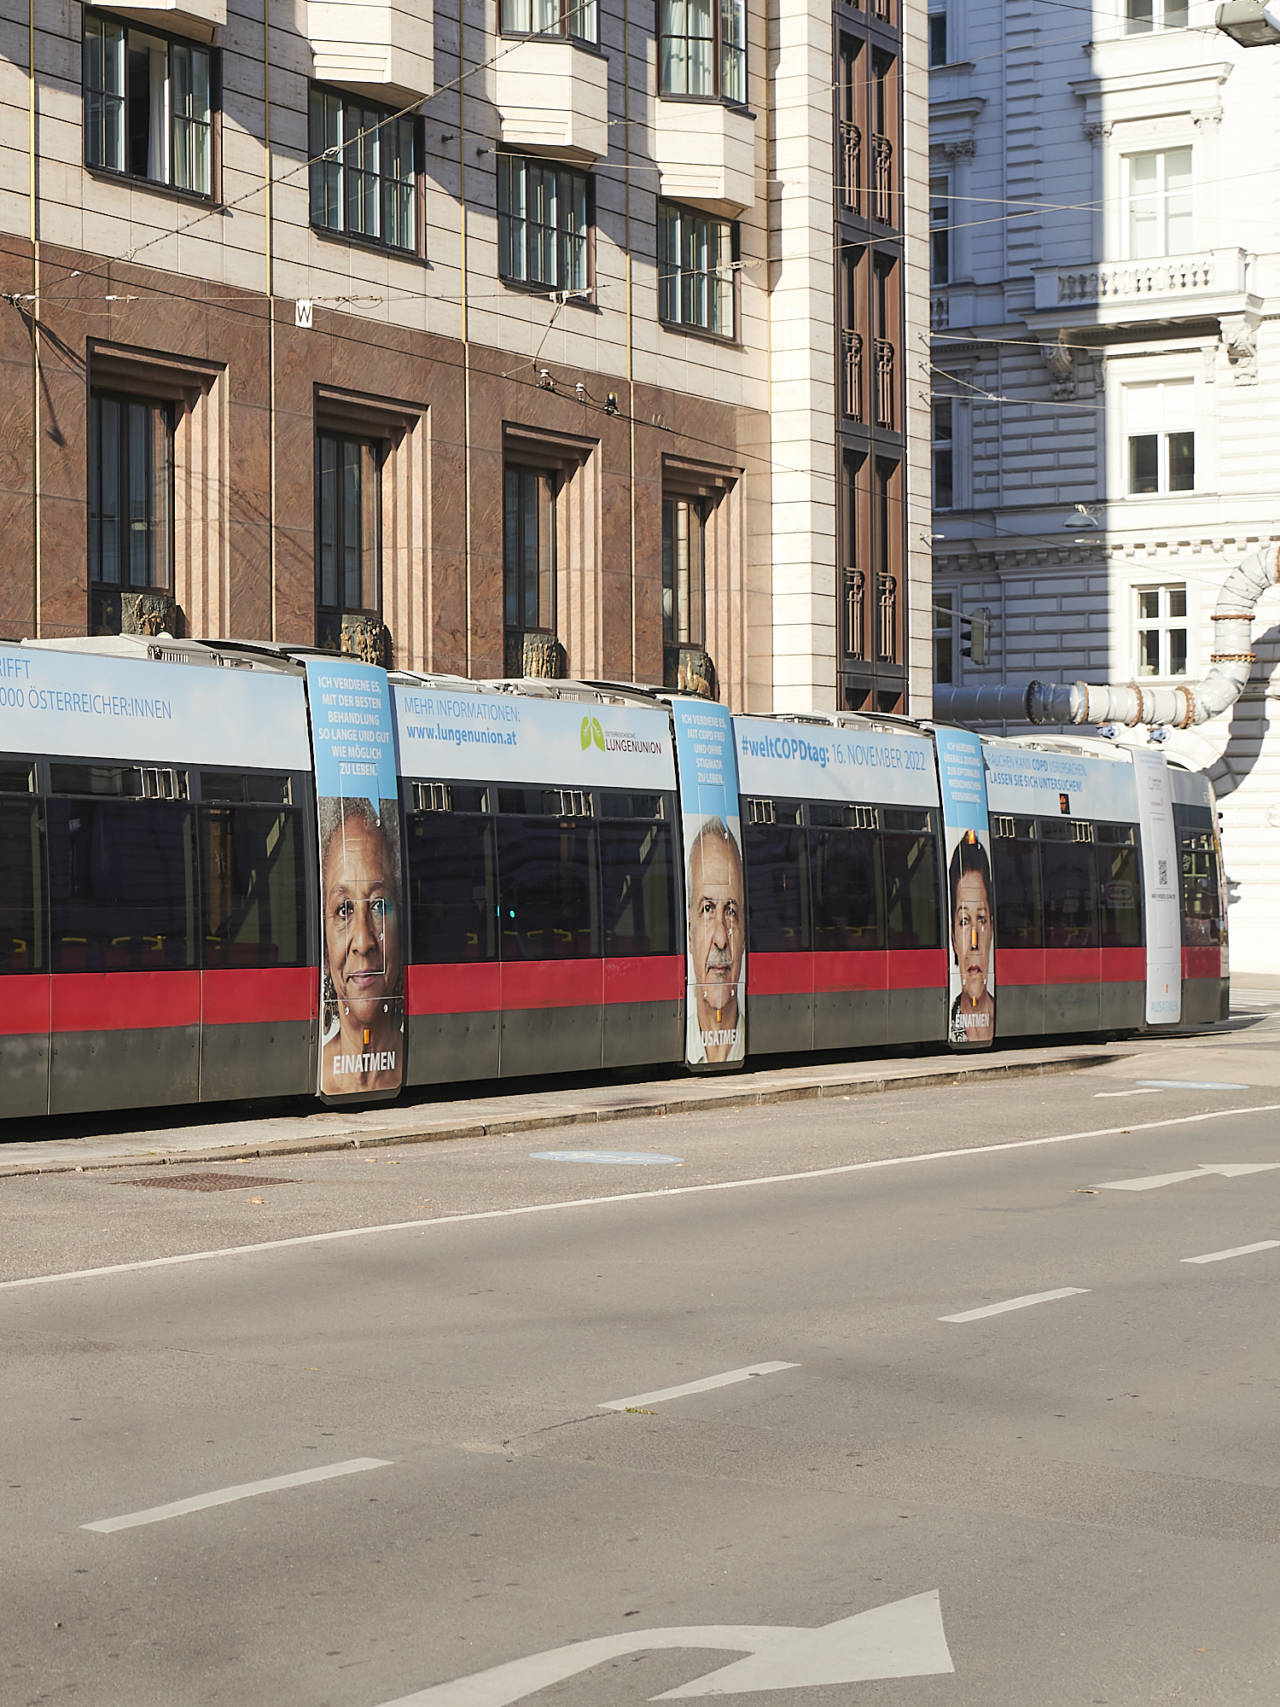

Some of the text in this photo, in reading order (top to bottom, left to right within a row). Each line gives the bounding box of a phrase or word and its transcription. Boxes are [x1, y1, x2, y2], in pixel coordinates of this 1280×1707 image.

[297, 305, 311, 323] W
[318, 676, 382, 694] ICH VERDIENE ES,
[28, 685, 172, 720] ÖSTERREICHER:INNEN
[322, 694, 382, 709] MIT DER BESTEN
[404, 696, 520, 723] MEHR INFORMATIONEN:
[327, 710, 380, 726] BEHANDLUNG
[681, 714, 692, 724] ICH
[693, 715, 719, 727] VERDIENE
[318, 727, 390, 743] SO LANGE UND GUT
[406, 723, 517, 746] www.lungenunion.at
[687, 729, 725, 742] MIT COPD FREI
[331, 744, 382, 759] WIE MÖGLICH
[605, 739, 662, 754] LUNGENUNION
[694, 744, 722, 756] UND OHNE
[741, 735, 926, 771] #weltCOPDtag: 16. NOVEMBER 2022
[340, 763, 377, 776] ZU LEBEN.
[696, 758, 723, 770] STIGMATA
[987, 753, 1015, 769] RAUCHEN
[1032, 758, 1048, 772] COPD
[697, 772, 706, 783] ZU
[989, 771, 1083, 792] LASSEN SIE SICH UNTERSUCHEN!
[955, 1013, 990, 1028] EINATMEN
[333, 1050, 396, 1075] EINATMEN
